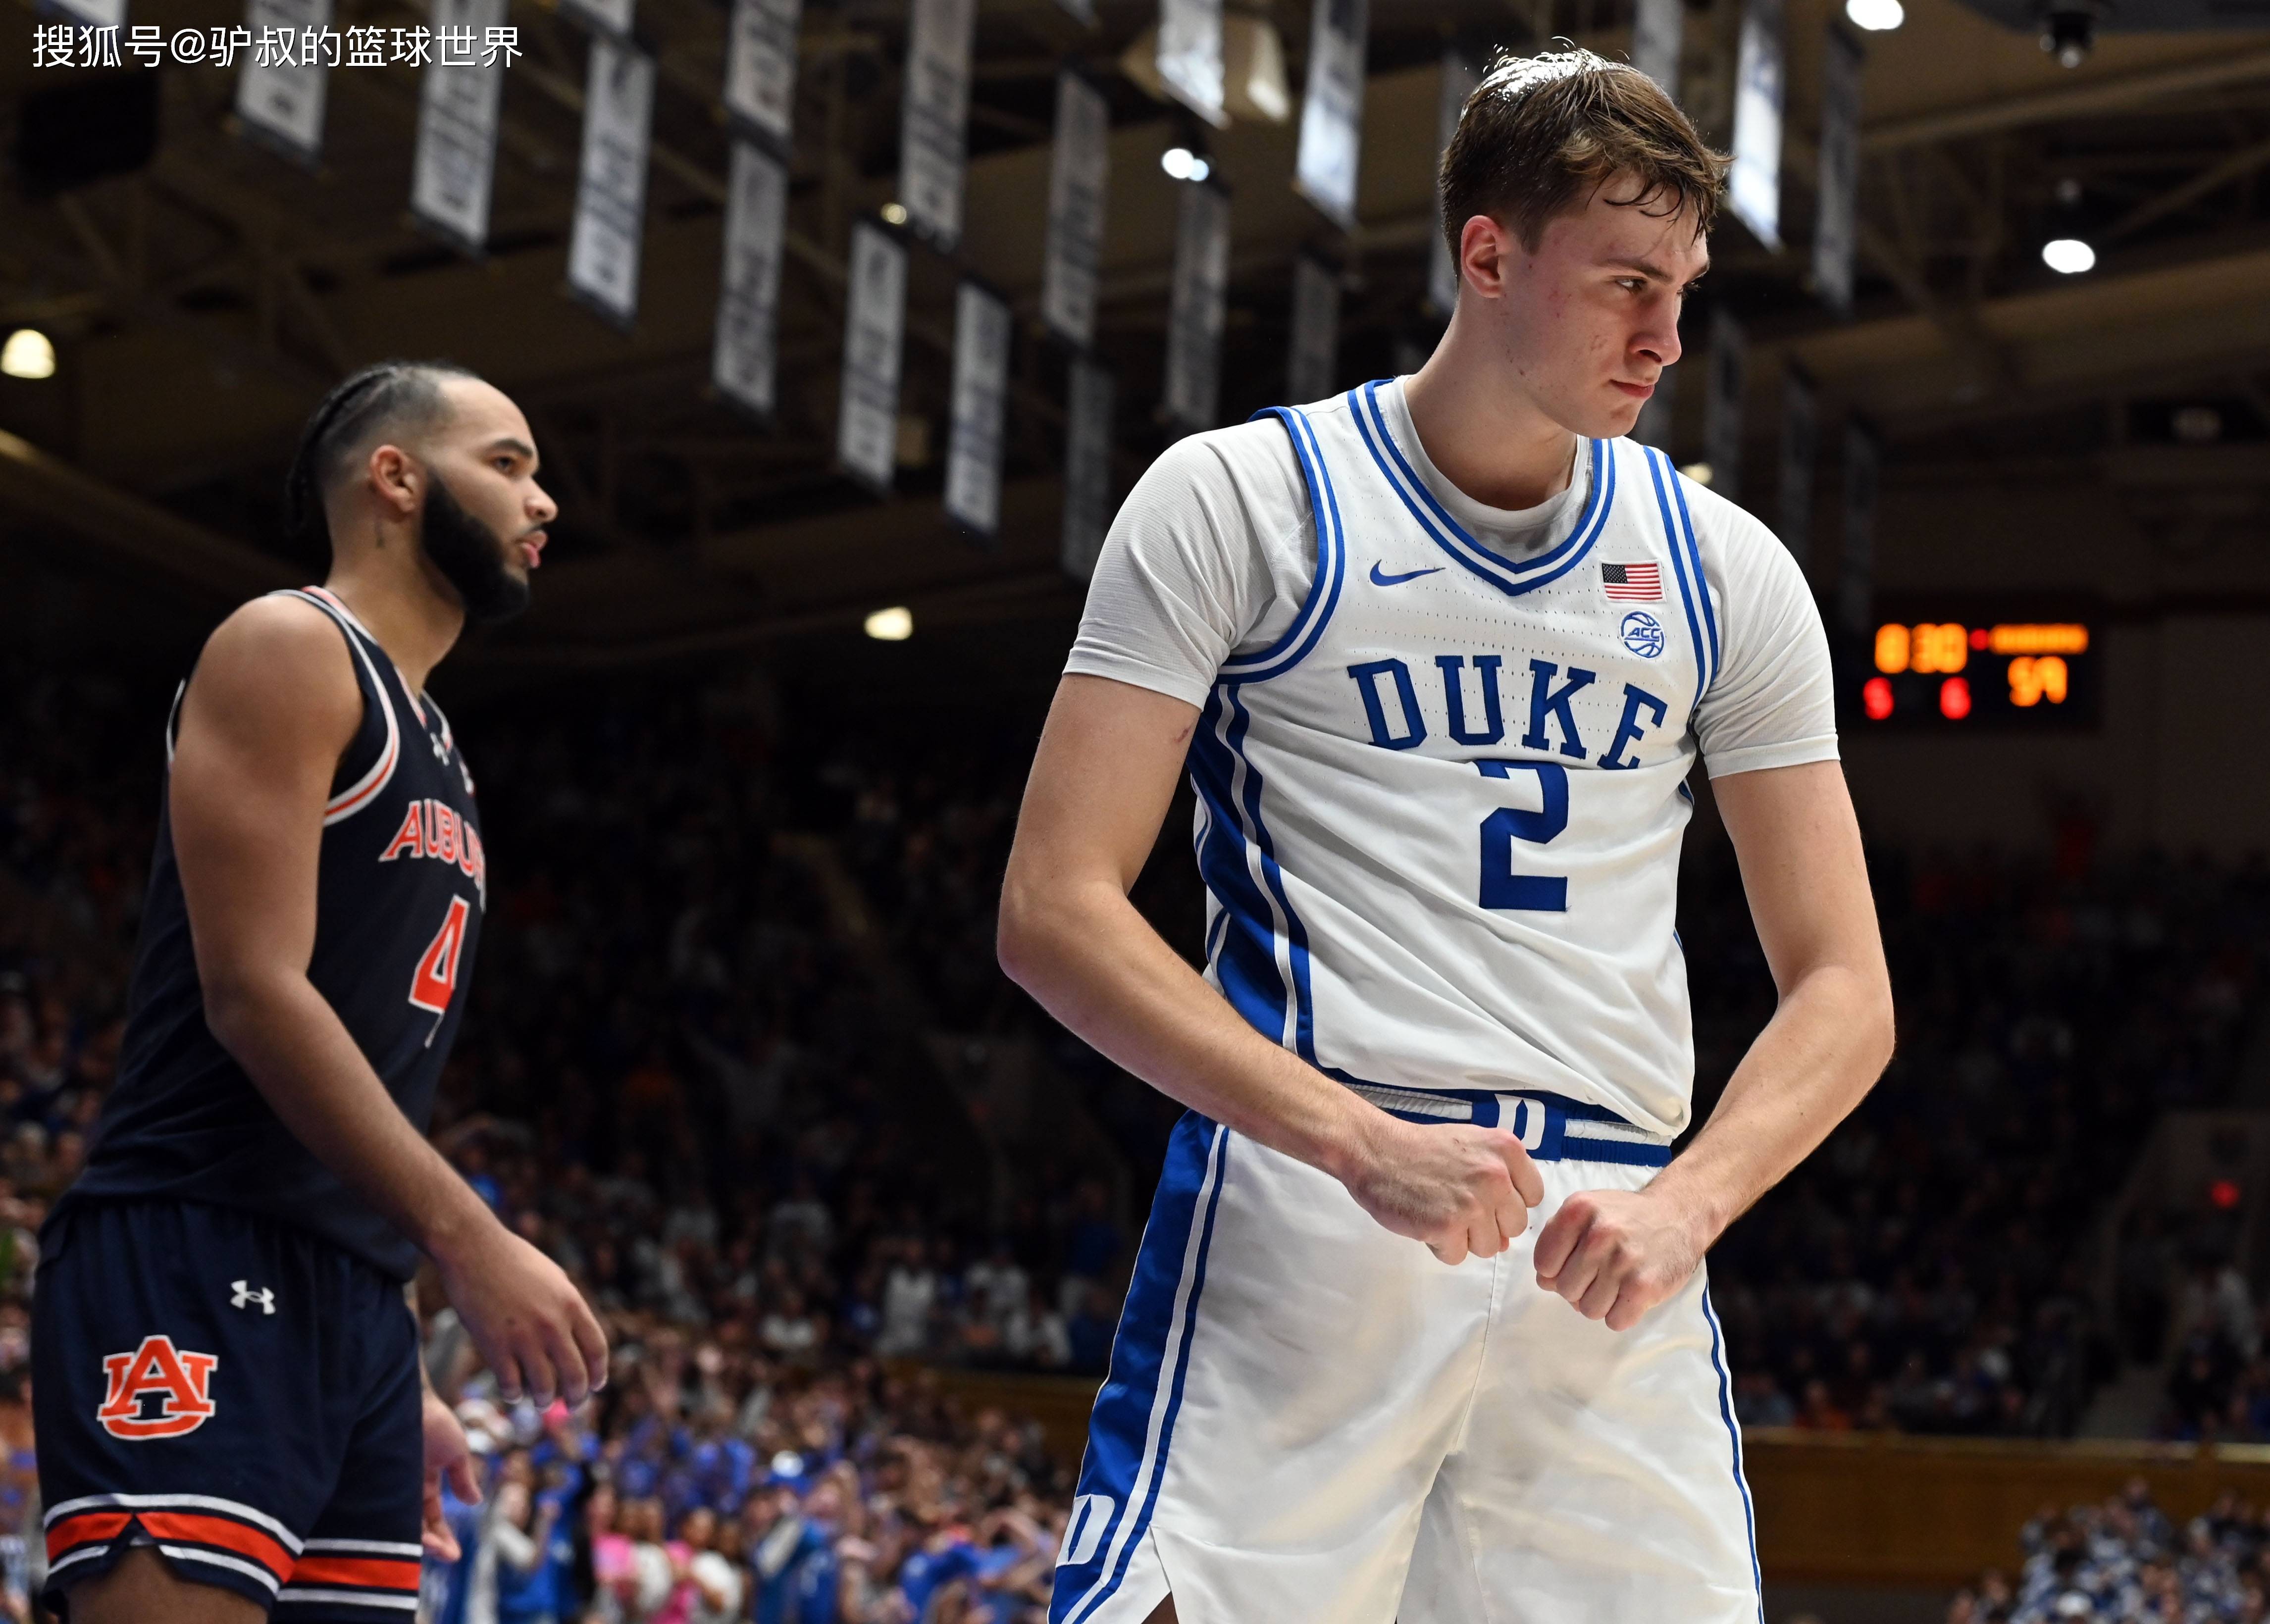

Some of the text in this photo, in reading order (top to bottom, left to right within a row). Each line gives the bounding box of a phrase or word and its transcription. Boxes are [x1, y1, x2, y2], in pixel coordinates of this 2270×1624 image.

[1627, 627, 1661, 639] ACC
[1347, 655, 1668, 770] DUKE
[1474, 759, 1569, 912] 2
[408, 894, 470, 1047] 4
